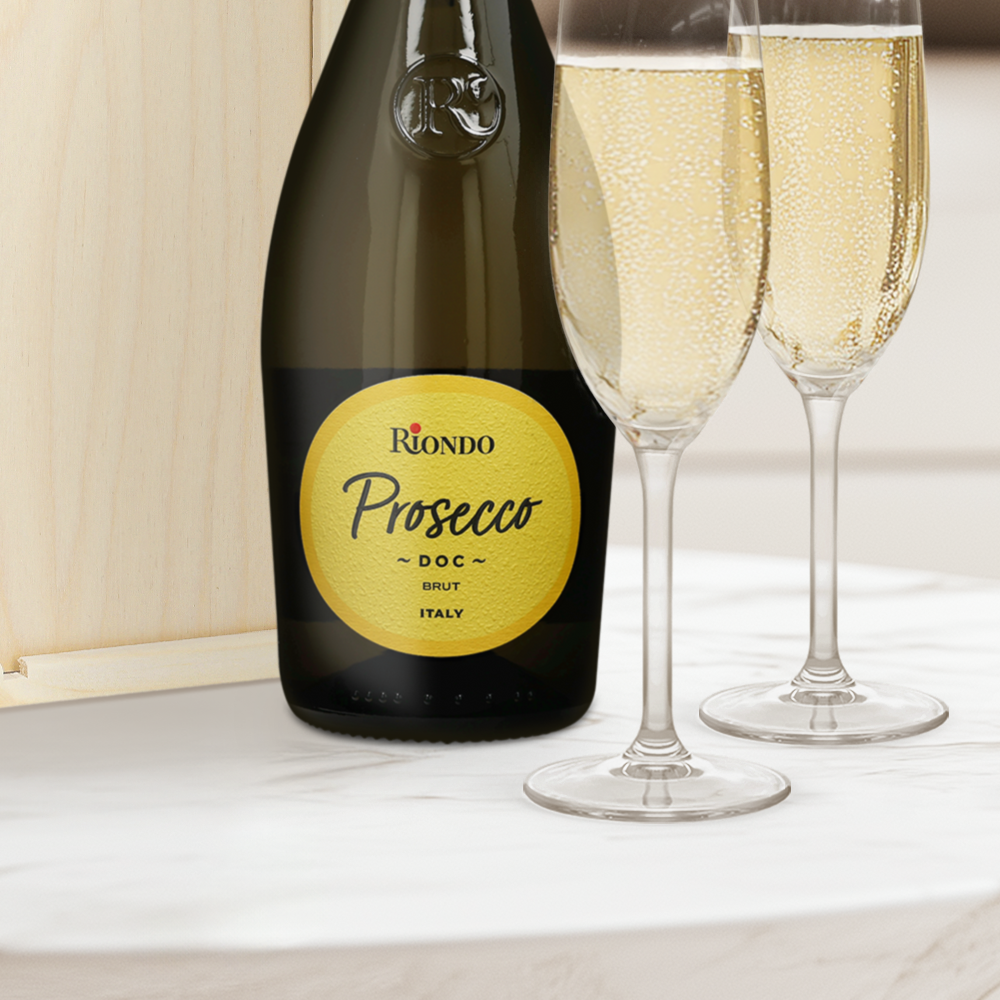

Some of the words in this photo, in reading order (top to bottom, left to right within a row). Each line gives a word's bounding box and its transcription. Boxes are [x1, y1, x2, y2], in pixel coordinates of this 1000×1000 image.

[342, 471, 543, 540] Prosecco
[419, 554, 465, 568] DOC
[422, 581, 461, 591] BRUT
[420, 608, 464, 619] ITALY
